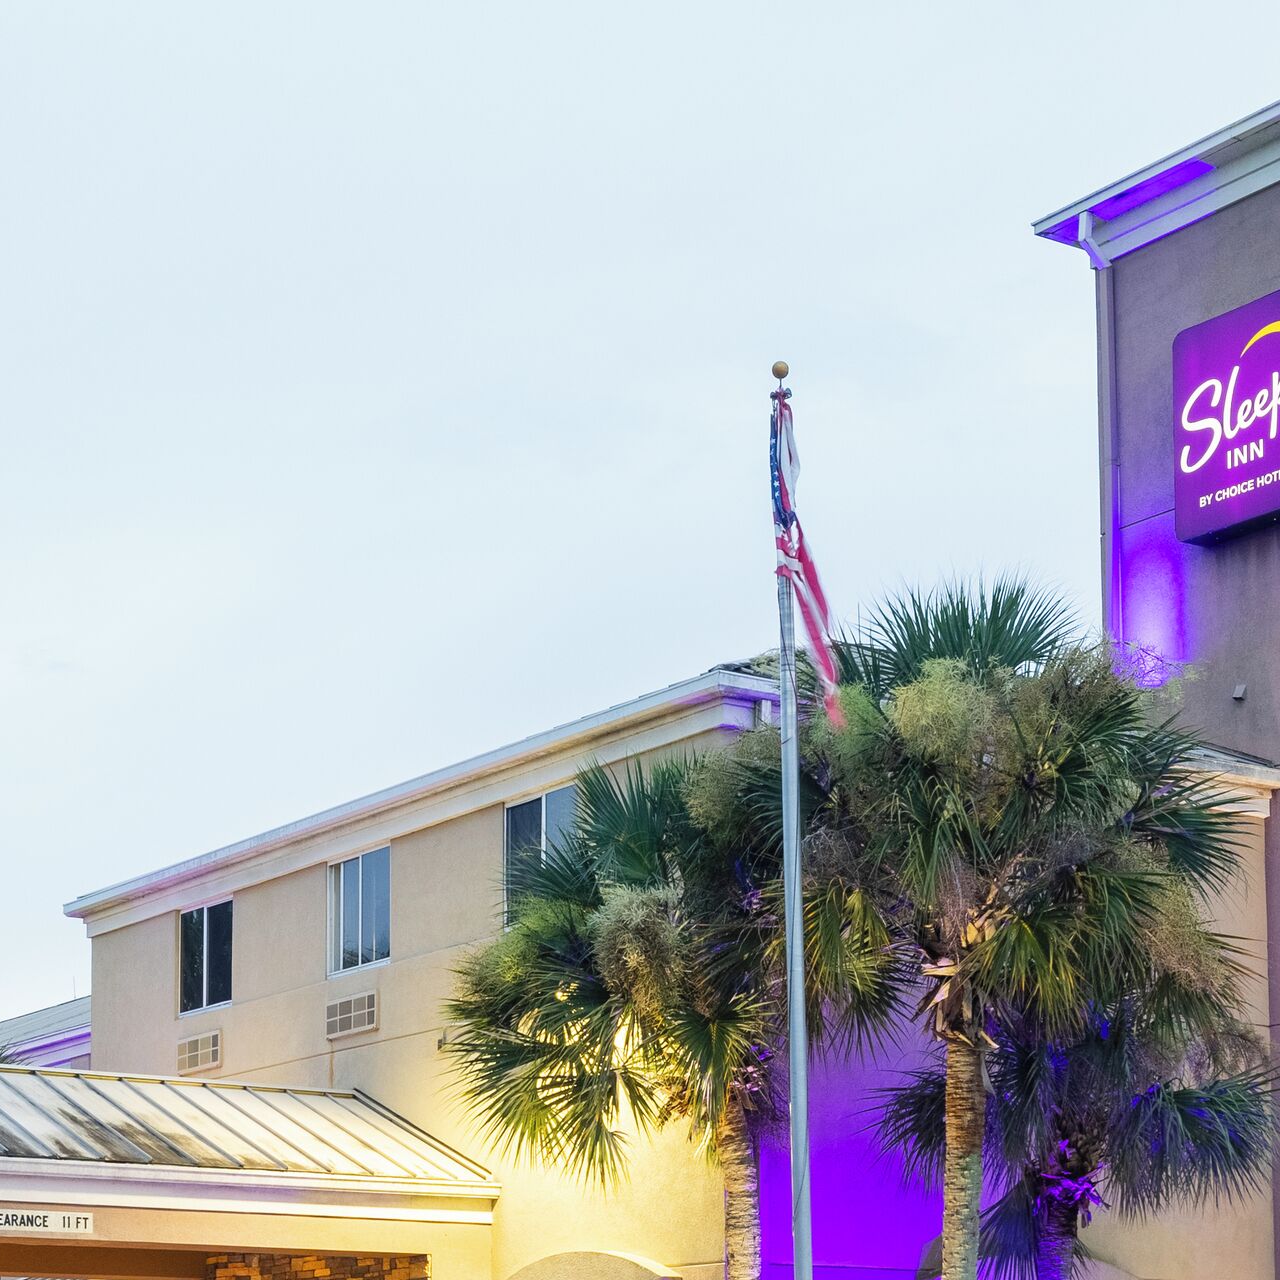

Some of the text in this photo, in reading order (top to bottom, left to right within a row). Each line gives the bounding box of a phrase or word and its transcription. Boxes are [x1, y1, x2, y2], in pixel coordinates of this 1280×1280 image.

[1226, 438, 1264, 470] INN
[1199, 492, 1214, 508] BY
[1215, 479, 1255, 502] CHOICE
[62, 1216, 71, 1228] 11
[76, 1217, 89, 1229] FT
